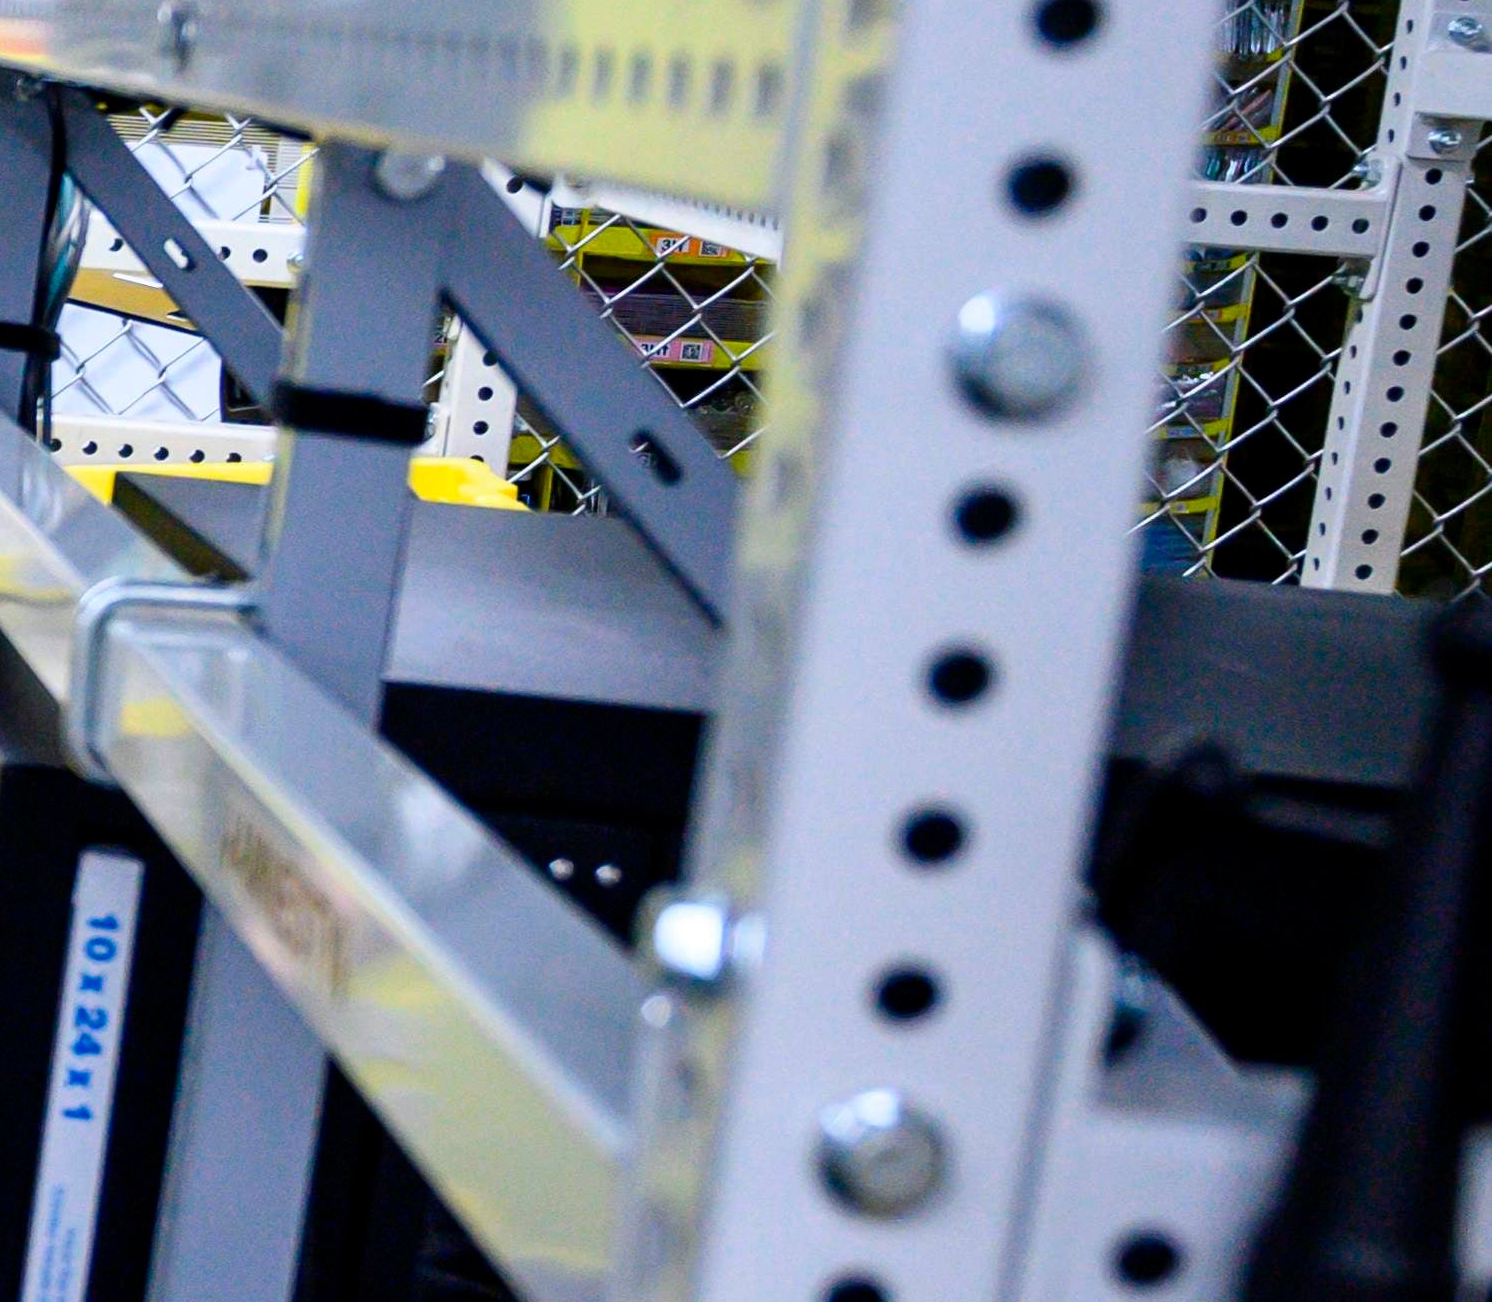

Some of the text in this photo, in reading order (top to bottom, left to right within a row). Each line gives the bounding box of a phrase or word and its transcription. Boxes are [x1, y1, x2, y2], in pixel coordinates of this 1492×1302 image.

[83, 913, 119, 962] 10
[72, 1005, 108, 1056] 24
[61, 1102, 94, 1122] 1
